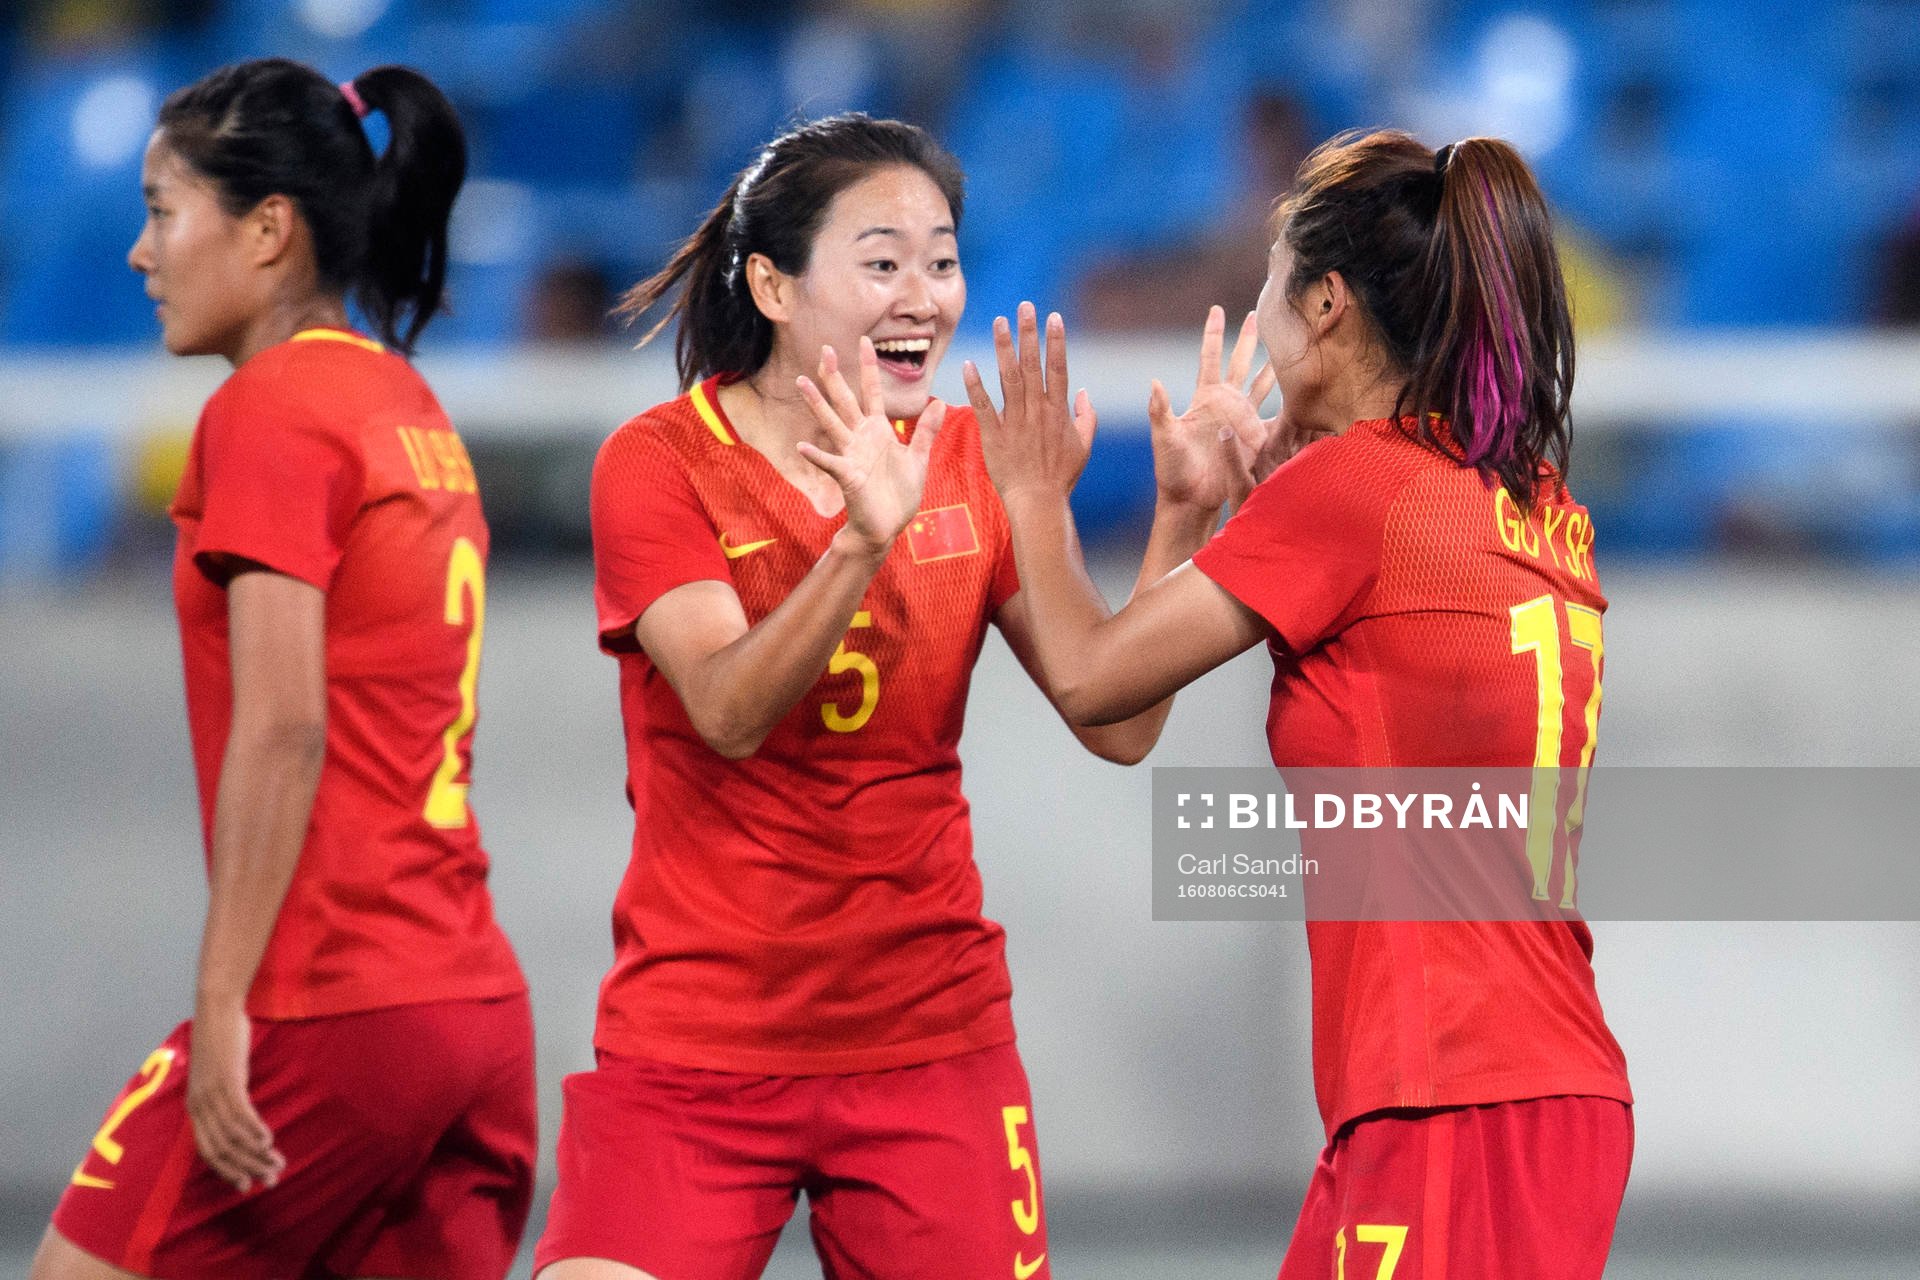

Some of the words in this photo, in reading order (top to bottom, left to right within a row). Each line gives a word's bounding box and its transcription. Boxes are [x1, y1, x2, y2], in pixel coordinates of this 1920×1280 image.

[422, 536, 486, 829] 2
[821, 611, 880, 733] 5
[1509, 594, 1604, 909] 17
[92, 1048, 176, 1165] 2
[1002, 1106, 1039, 1235] 5
[1335, 1224, 1409, 1280] 17
